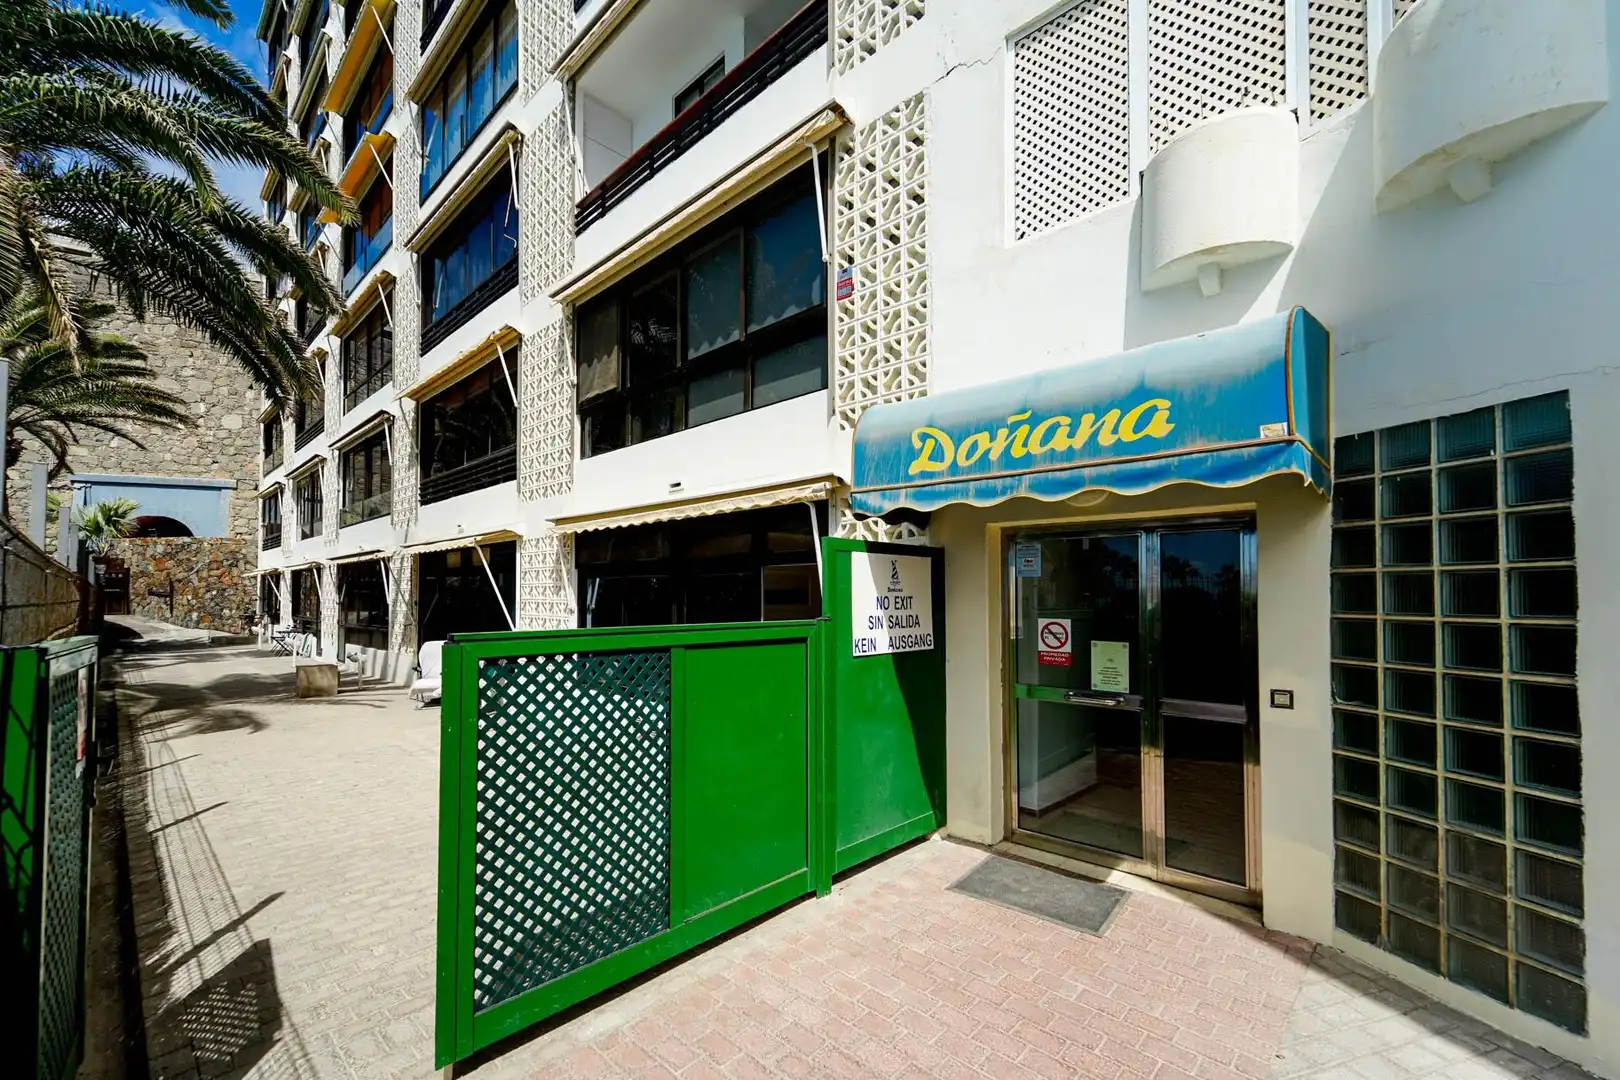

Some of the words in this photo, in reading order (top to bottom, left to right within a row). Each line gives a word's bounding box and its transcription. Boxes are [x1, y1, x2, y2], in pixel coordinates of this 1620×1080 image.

[908, 398, 1175, 475] Doñana
[876, 596, 890, 610] NO
[894, 596, 913, 610] EXIT
[868, 615, 884, 630] SIN
[888, 614, 921, 629] SALIDA
[854, 637, 877, 653] KEIN
[888, 633, 932, 650] AUSGANG
